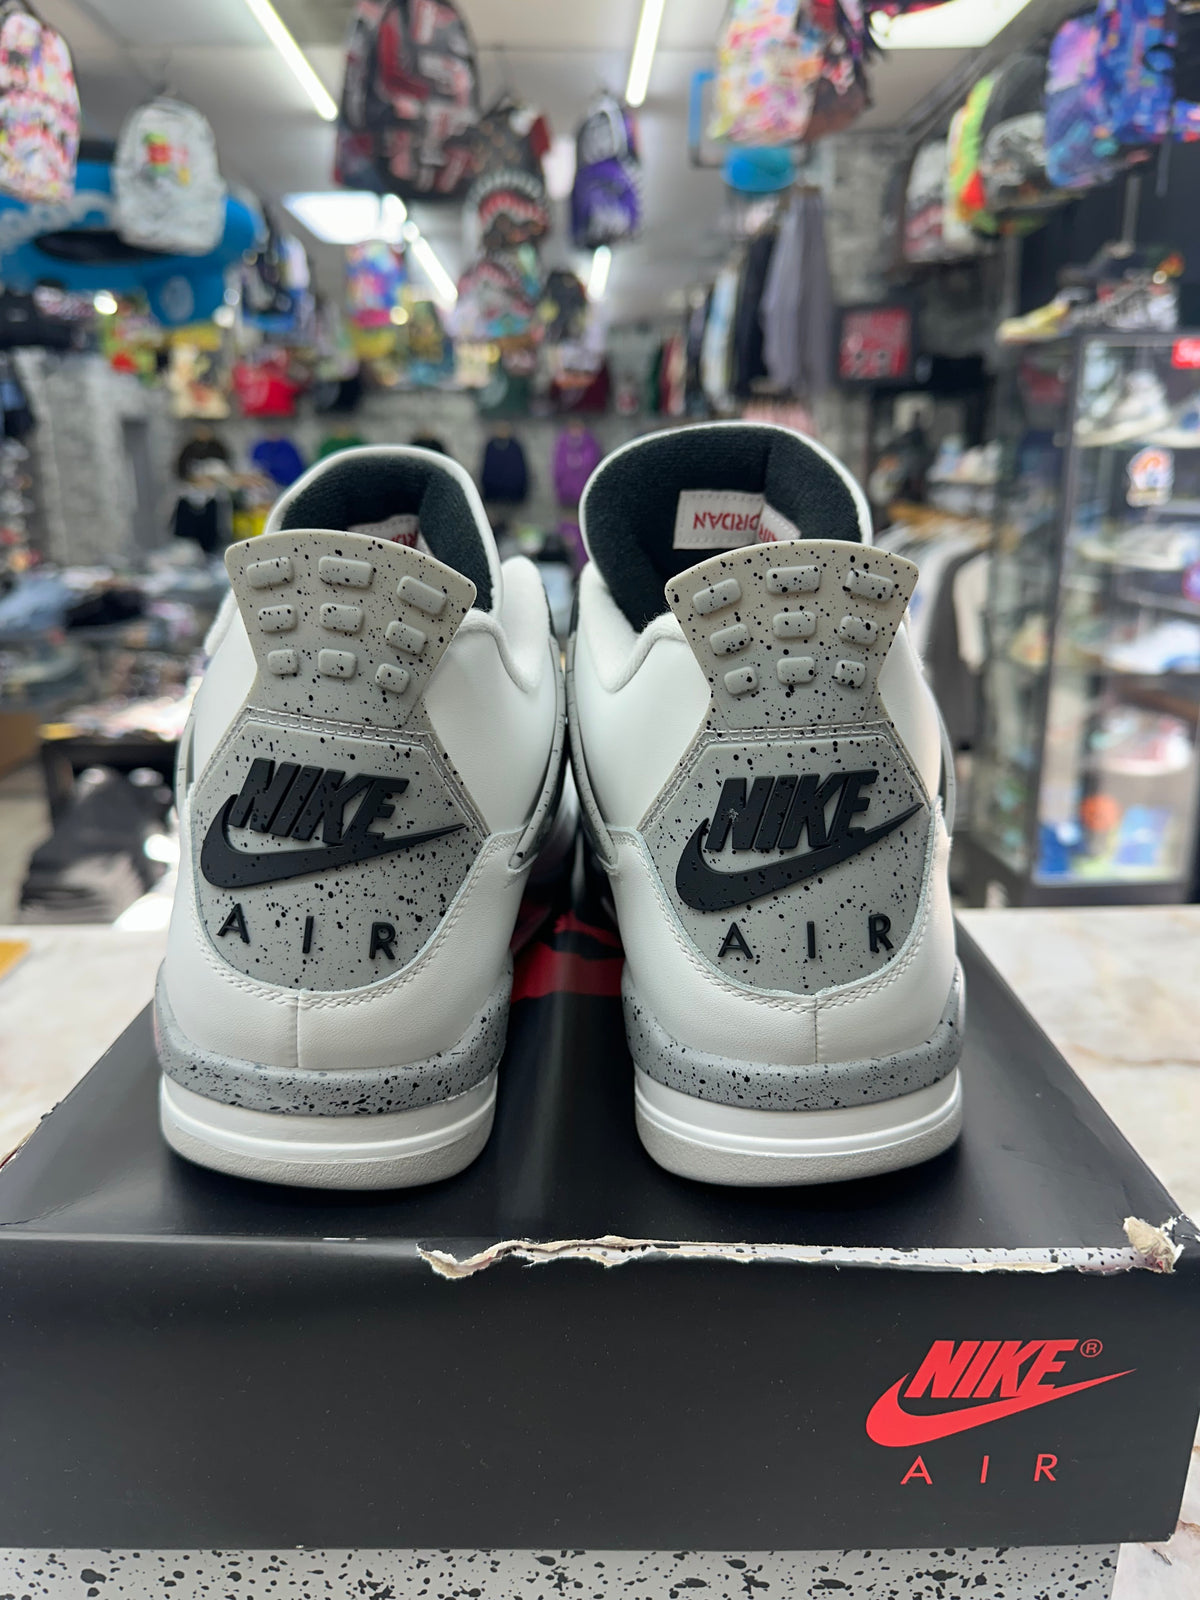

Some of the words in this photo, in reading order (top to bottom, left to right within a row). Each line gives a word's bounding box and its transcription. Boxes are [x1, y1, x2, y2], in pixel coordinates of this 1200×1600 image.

[692, 510, 761, 532] ORDAN
[227, 757, 410, 847] NIKE
[705, 769, 880, 850] NIKE
[216, 902, 397, 960] AIR
[717, 912, 895, 960] AIR
[900, 1453, 1059, 1485] AIR
